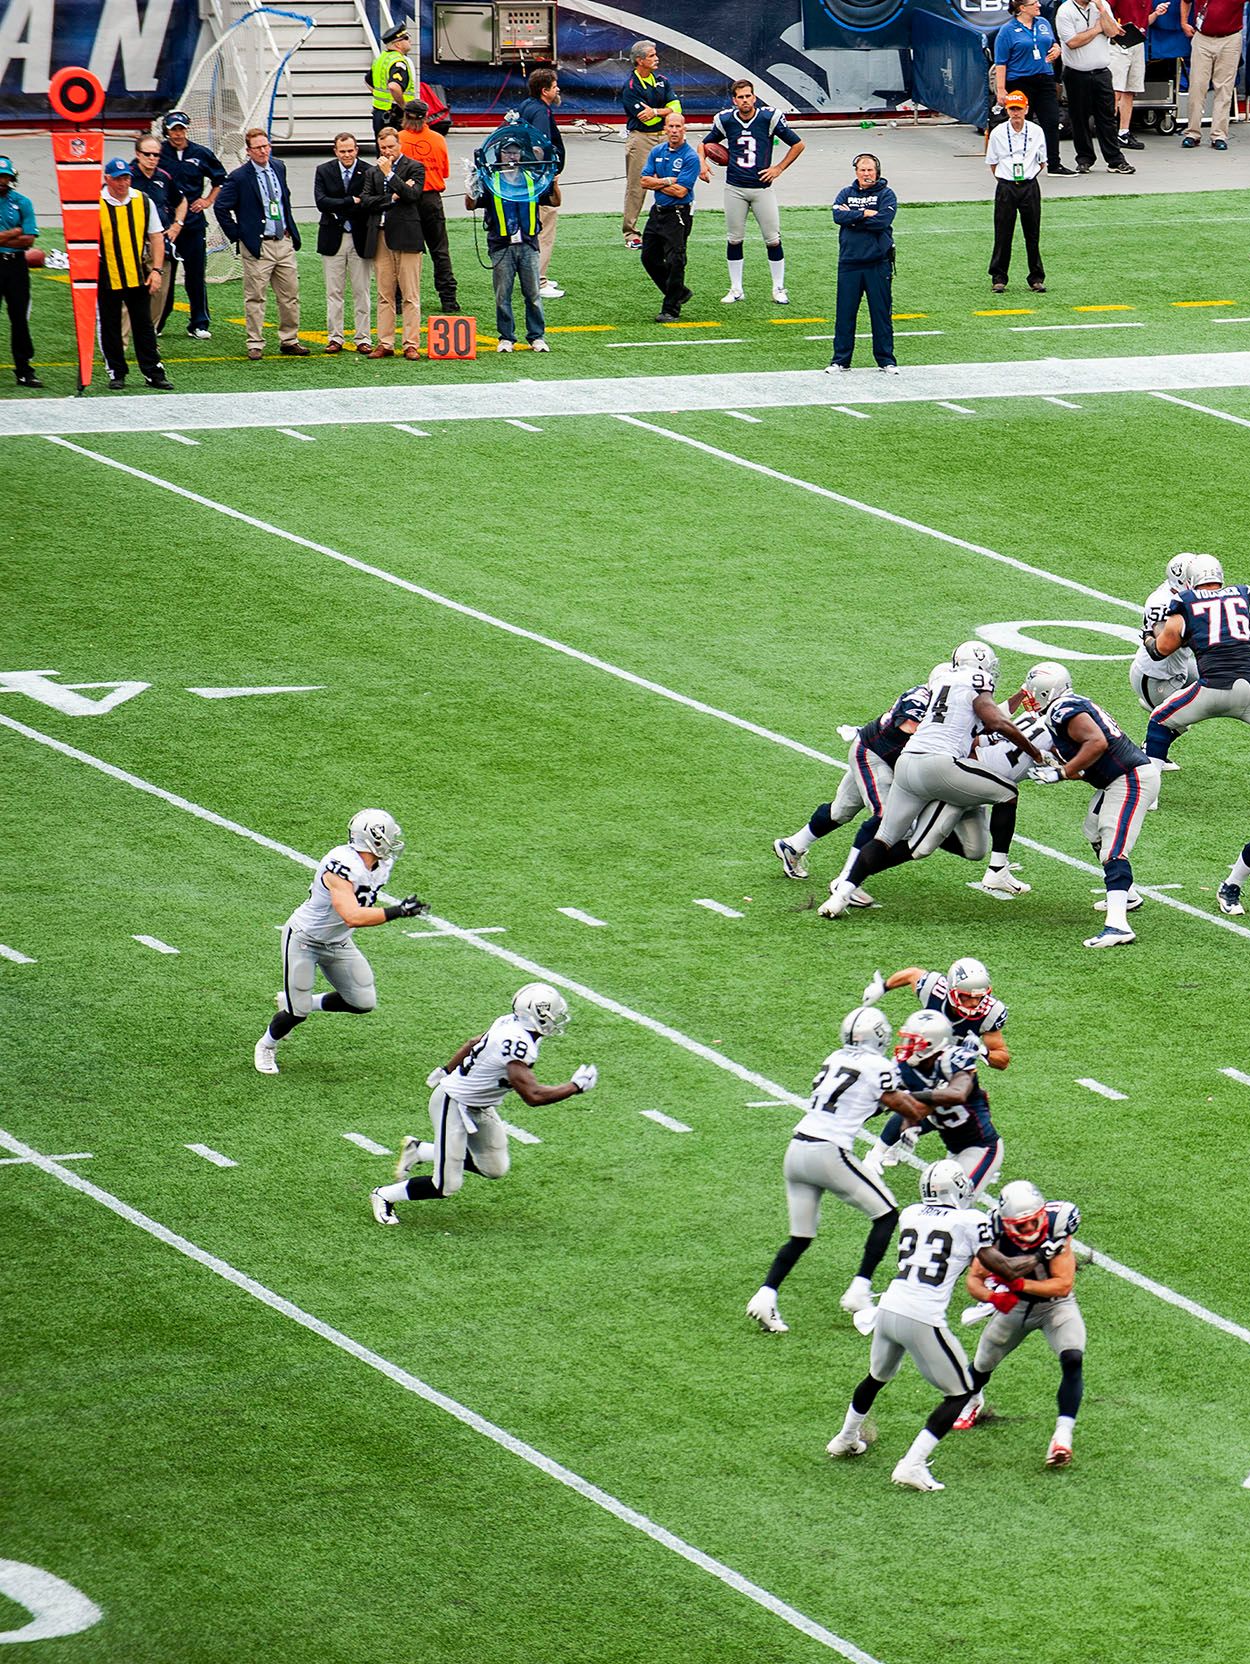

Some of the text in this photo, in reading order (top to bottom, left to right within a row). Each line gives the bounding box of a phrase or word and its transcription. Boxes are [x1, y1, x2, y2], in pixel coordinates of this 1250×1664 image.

[736, 136, 757, 168] 3
[433, 318, 471, 356] 30
[501, 1039, 528, 1060] 38
[896, 1227, 953, 1288] 23
